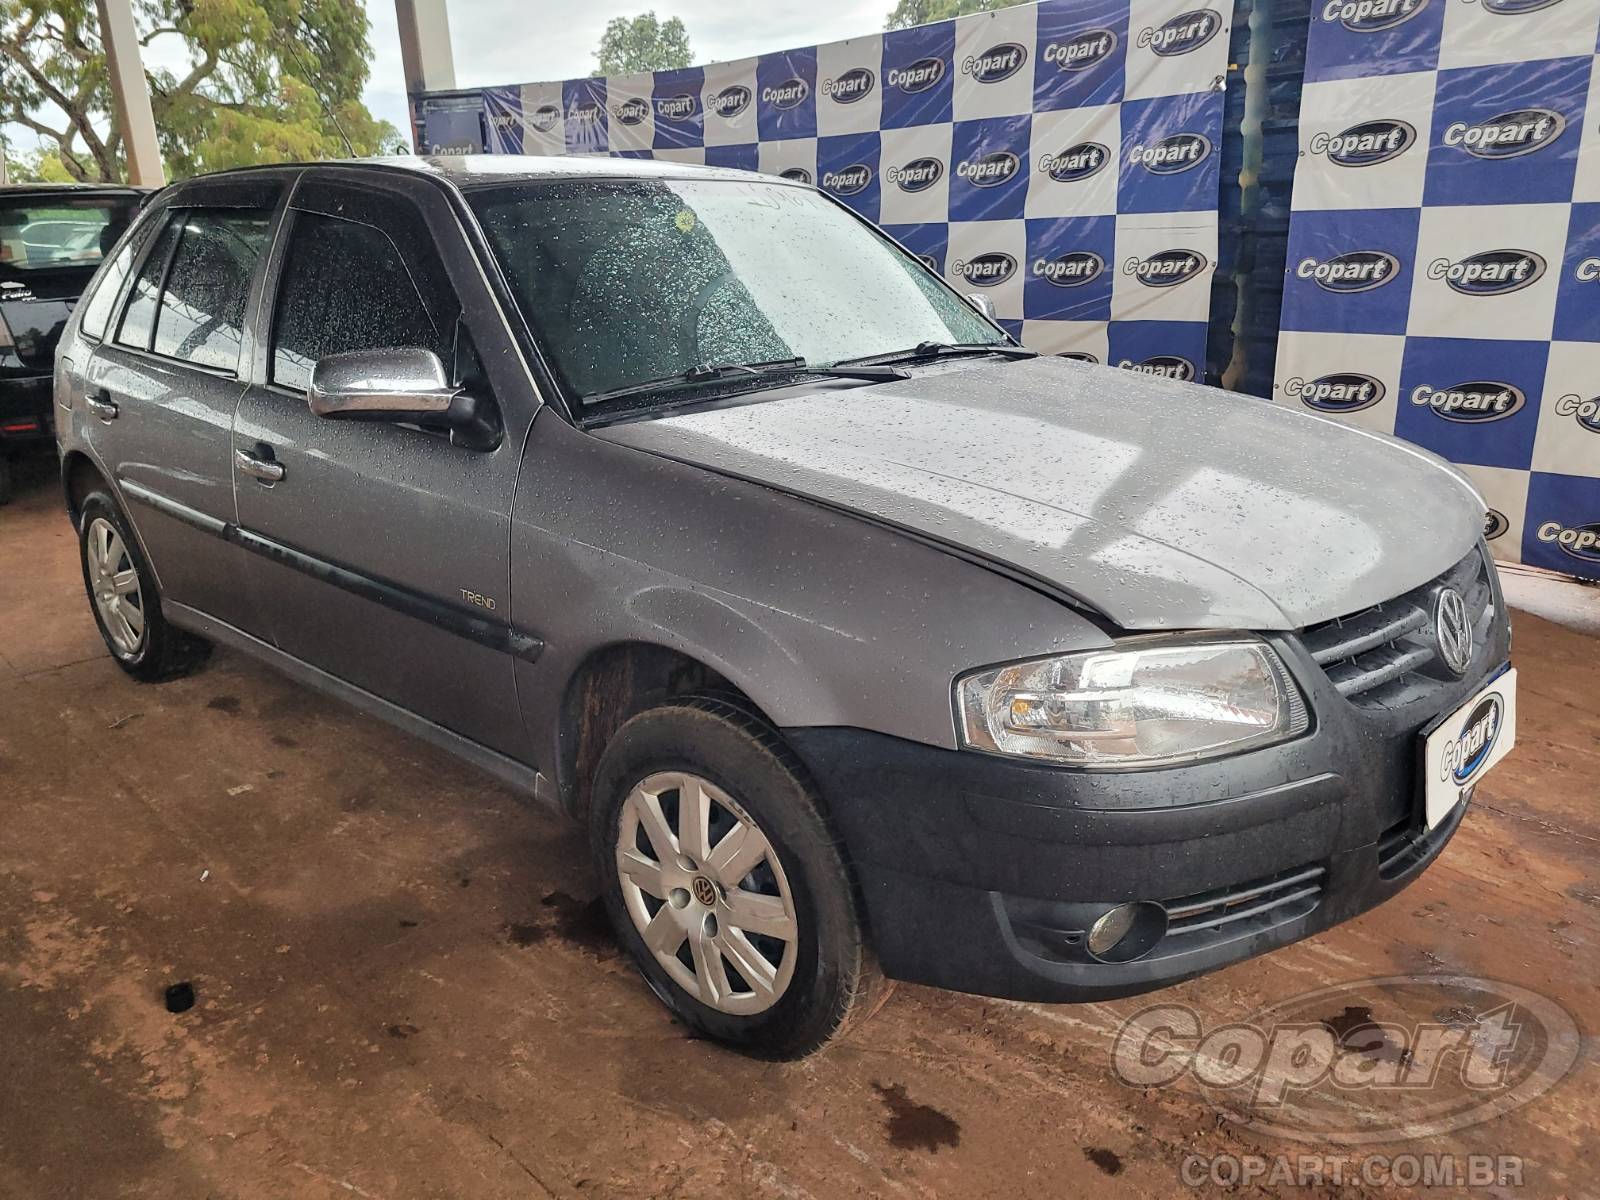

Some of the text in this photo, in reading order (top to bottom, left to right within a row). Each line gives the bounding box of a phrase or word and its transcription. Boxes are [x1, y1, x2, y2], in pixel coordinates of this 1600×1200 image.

[1322, 0, 1416, 24] Copart
[1137, 16, 1213, 48] Copart
[961, 51, 1020, 79] Copart
[1043, 36, 1107, 69] Copart
[822, 73, 869, 98] Copart
[888, 64, 940, 91] Copart
[657, 97, 691, 119] Copart
[707, 91, 745, 117] Copart
[763, 86, 803, 105] Copart
[1310, 127, 1401, 158] Copart
[1444, 117, 1552, 148] Copart
[1038, 149, 1100, 180] Copart
[1129, 137, 1200, 166] Copart
[823, 170, 866, 190] Copart
[886, 161, 936, 184] Copart
[957, 160, 1011, 181] Copart
[952, 257, 1010, 278] Copart
[1033, 257, 1093, 279] Copart
[1122, 256, 1197, 284] Copart
[1297, 256, 1388, 280] Copart
[1427, 256, 1530, 284] Copart
[1284, 377, 1374, 401] Copart
[1411, 385, 1512, 412] Copart
[1537, 521, 1600, 550] Cop
[460, 588, 496, 610] TREND
[1440, 700, 1497, 782] Copart
